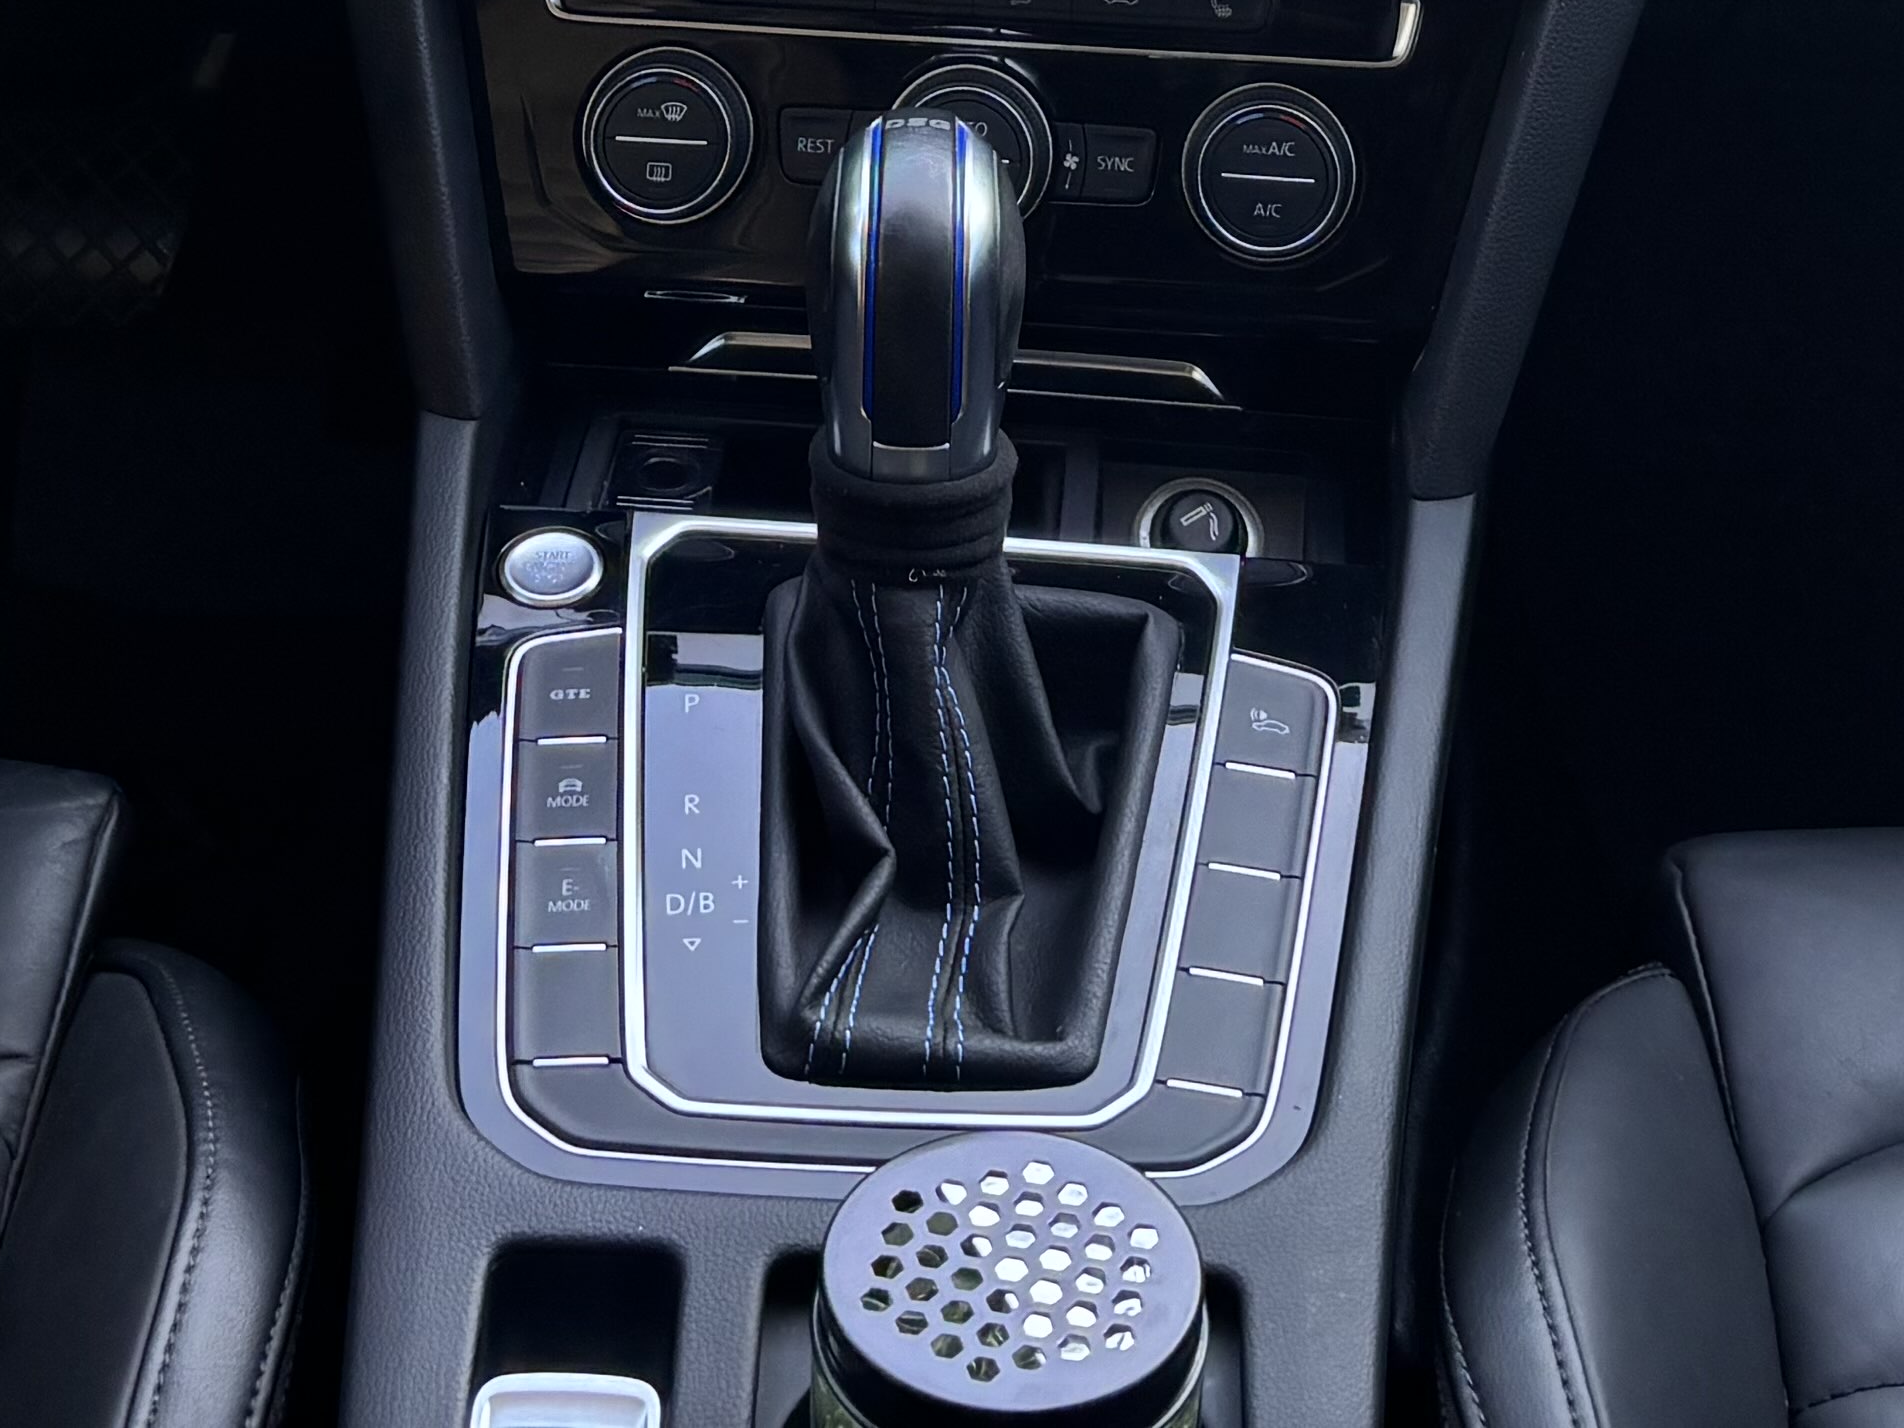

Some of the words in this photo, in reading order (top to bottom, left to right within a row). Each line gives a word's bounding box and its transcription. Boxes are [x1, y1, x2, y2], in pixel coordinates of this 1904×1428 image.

[636, 108, 661, 119] MAX
[884, 117, 951, 131] DSG
[796, 137, 836, 154] REST
[1096, 155, 1135, 173] SYNC
[1253, 202, 1283, 219] A/C
[549, 688, 591, 701] GTE
[684, 693, 700, 713] P
[546, 794, 590, 809] MODE
[684, 794, 700, 815] R
[681, 847, 703, 869] N
[561, 878, 580, 896] E-
[547, 899, 591, 913] MODE
[665, 891, 716, 916] D/B
